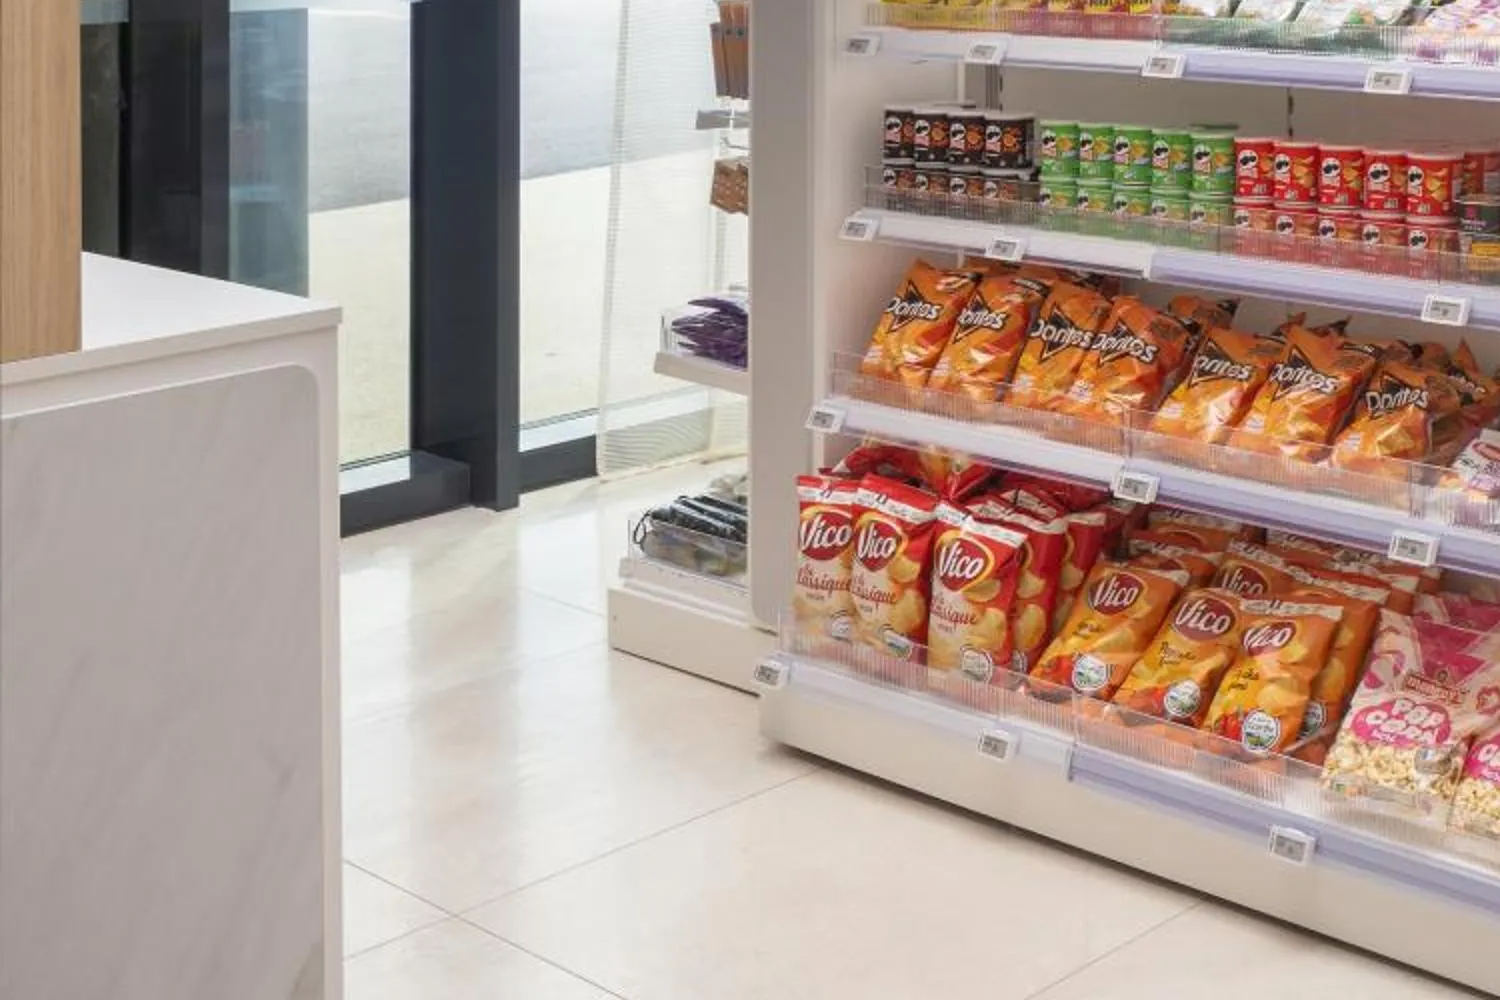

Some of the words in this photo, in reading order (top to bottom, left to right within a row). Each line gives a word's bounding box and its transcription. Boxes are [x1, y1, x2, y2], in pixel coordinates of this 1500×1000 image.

[959, 306, 1008, 329] oritos
[1194, 354, 1253, 380] oritos
[1366, 388, 1429, 411] Doritos
[800, 512, 851, 550] Vico
[857, 522, 897, 559] Vico
[938, 541, 984, 579] Vico
[1094, 576, 1139, 607] Vico
[1222, 568, 1263, 597] Vico
[1175, 598, 1231, 635] Vico
[1243, 625, 1293, 649] Vico
[1365, 710, 1440, 745] CORN
[1392, 698, 1446, 728] POP
